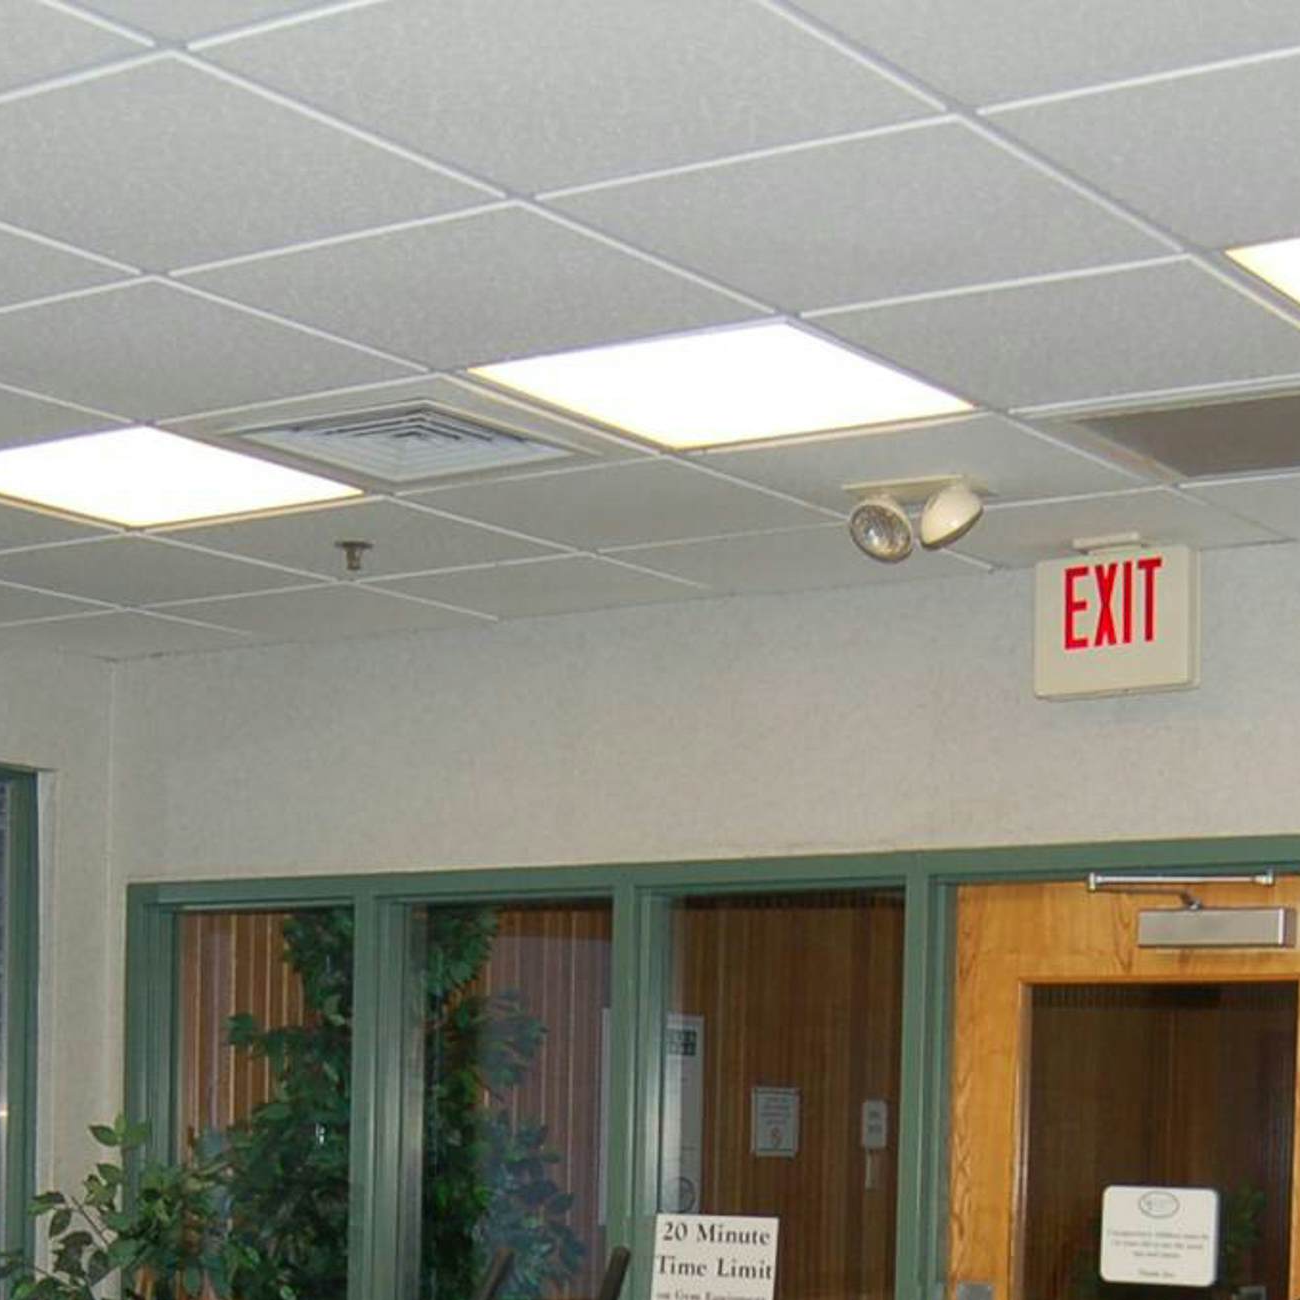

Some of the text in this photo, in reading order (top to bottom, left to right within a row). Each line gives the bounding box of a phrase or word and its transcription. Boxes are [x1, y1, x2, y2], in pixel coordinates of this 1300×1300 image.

[1064, 557, 1163, 650] EXIT
[662, 1221, 771, 1246] 20 Minute
[656, 1254, 773, 1280] Time Limit
